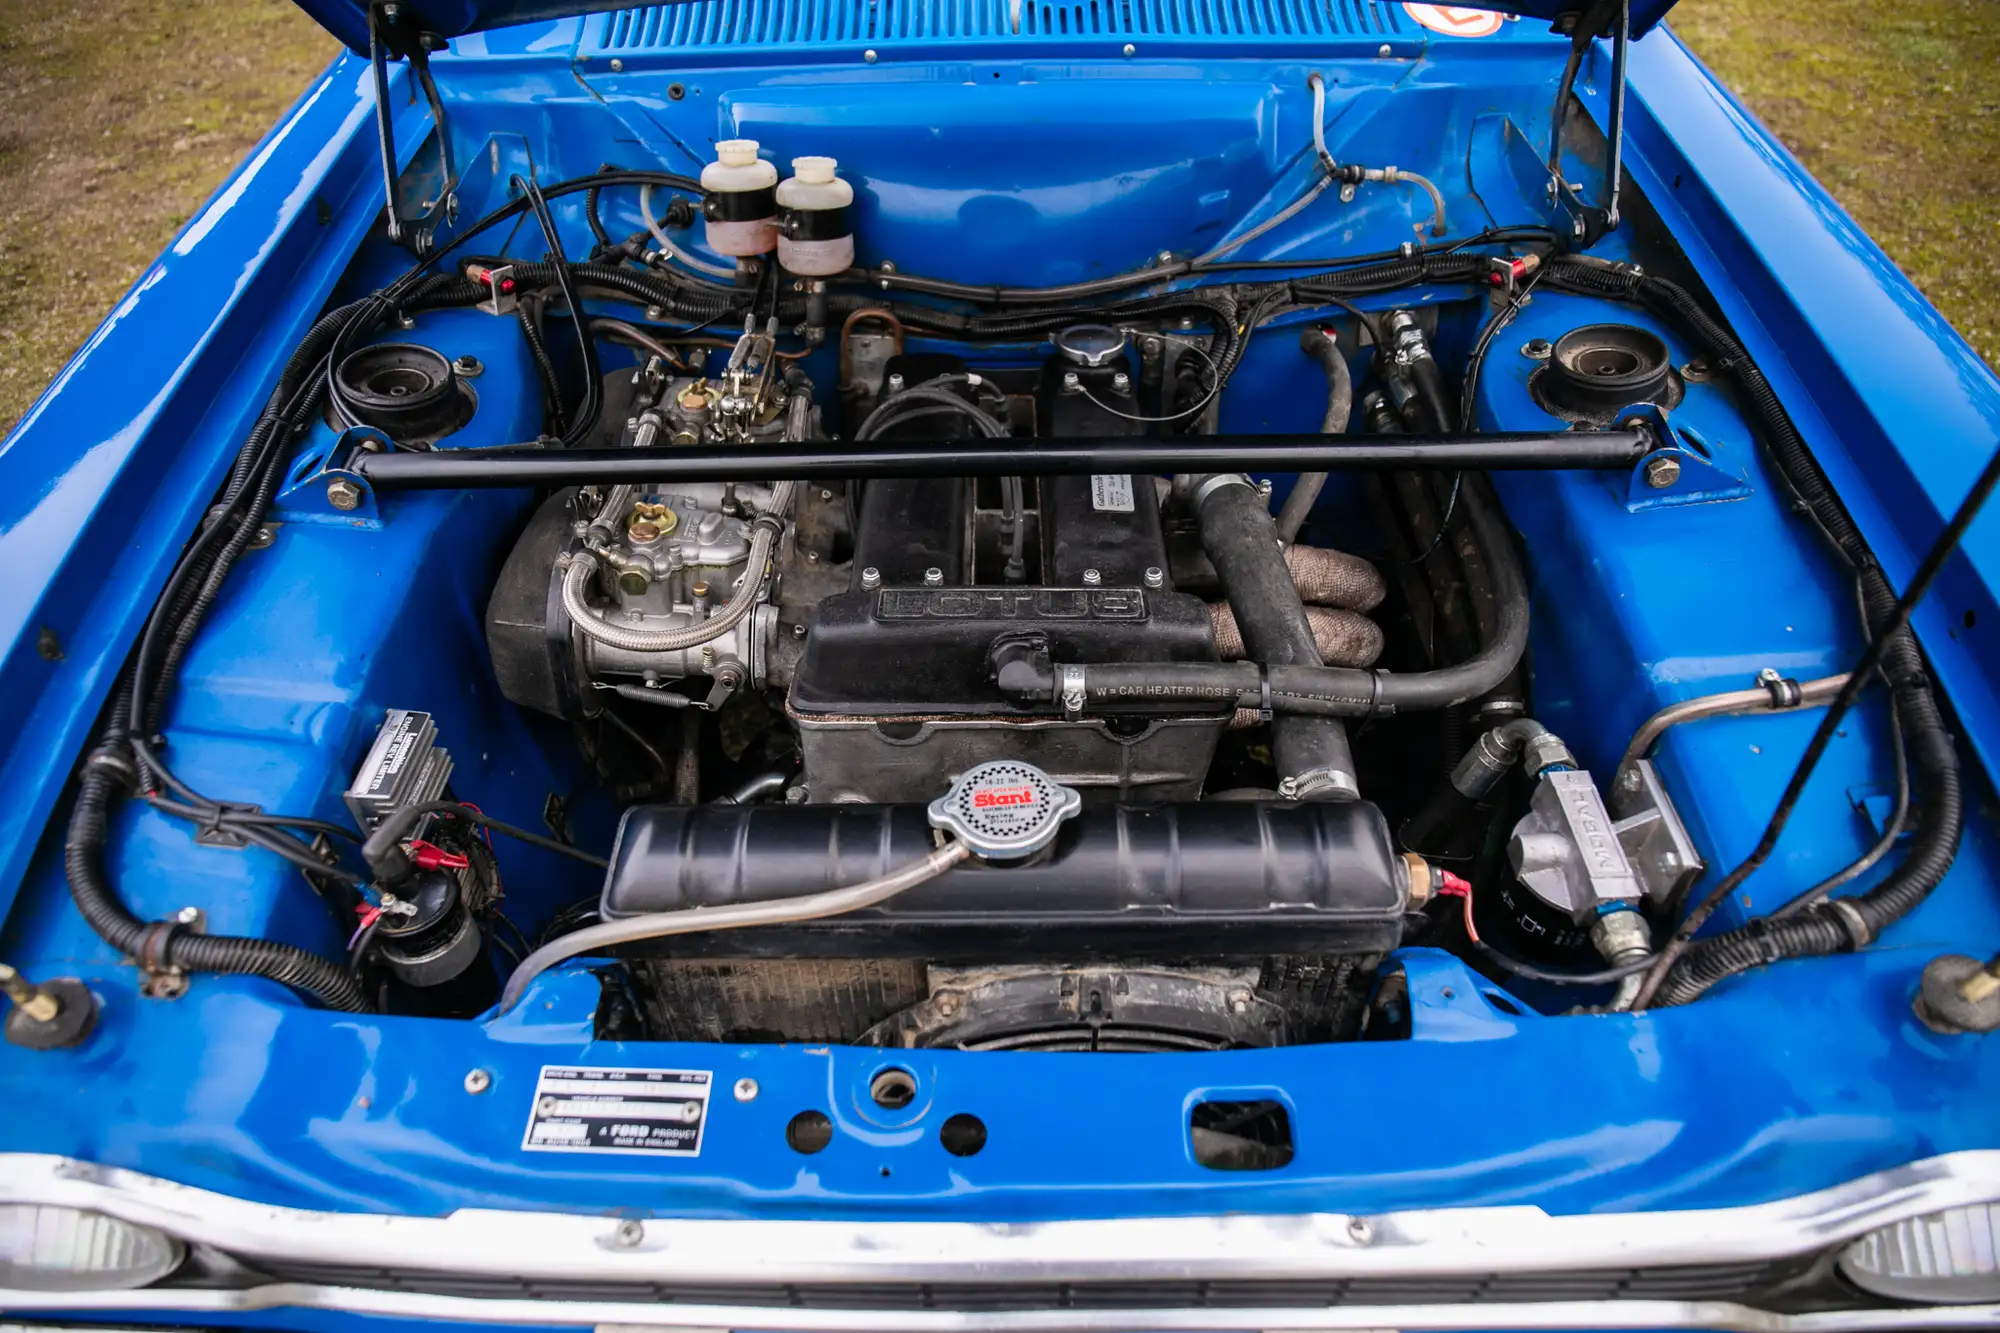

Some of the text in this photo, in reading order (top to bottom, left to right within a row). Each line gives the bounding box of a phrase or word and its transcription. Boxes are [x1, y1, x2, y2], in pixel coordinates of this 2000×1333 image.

[883, 590, 1141, 617] LOTUS
[1119, 686, 1143, 696] CAR
[1147, 686, 1194, 696] HEATER
[1196, 686, 1230, 697] HOSE
[393, 716, 414, 743] ENGINE
[370, 760, 392, 790] LIMITER
[974, 791, 1032, 807] Stant
[599, 1124, 697, 1140] A FORD PRODUCT
